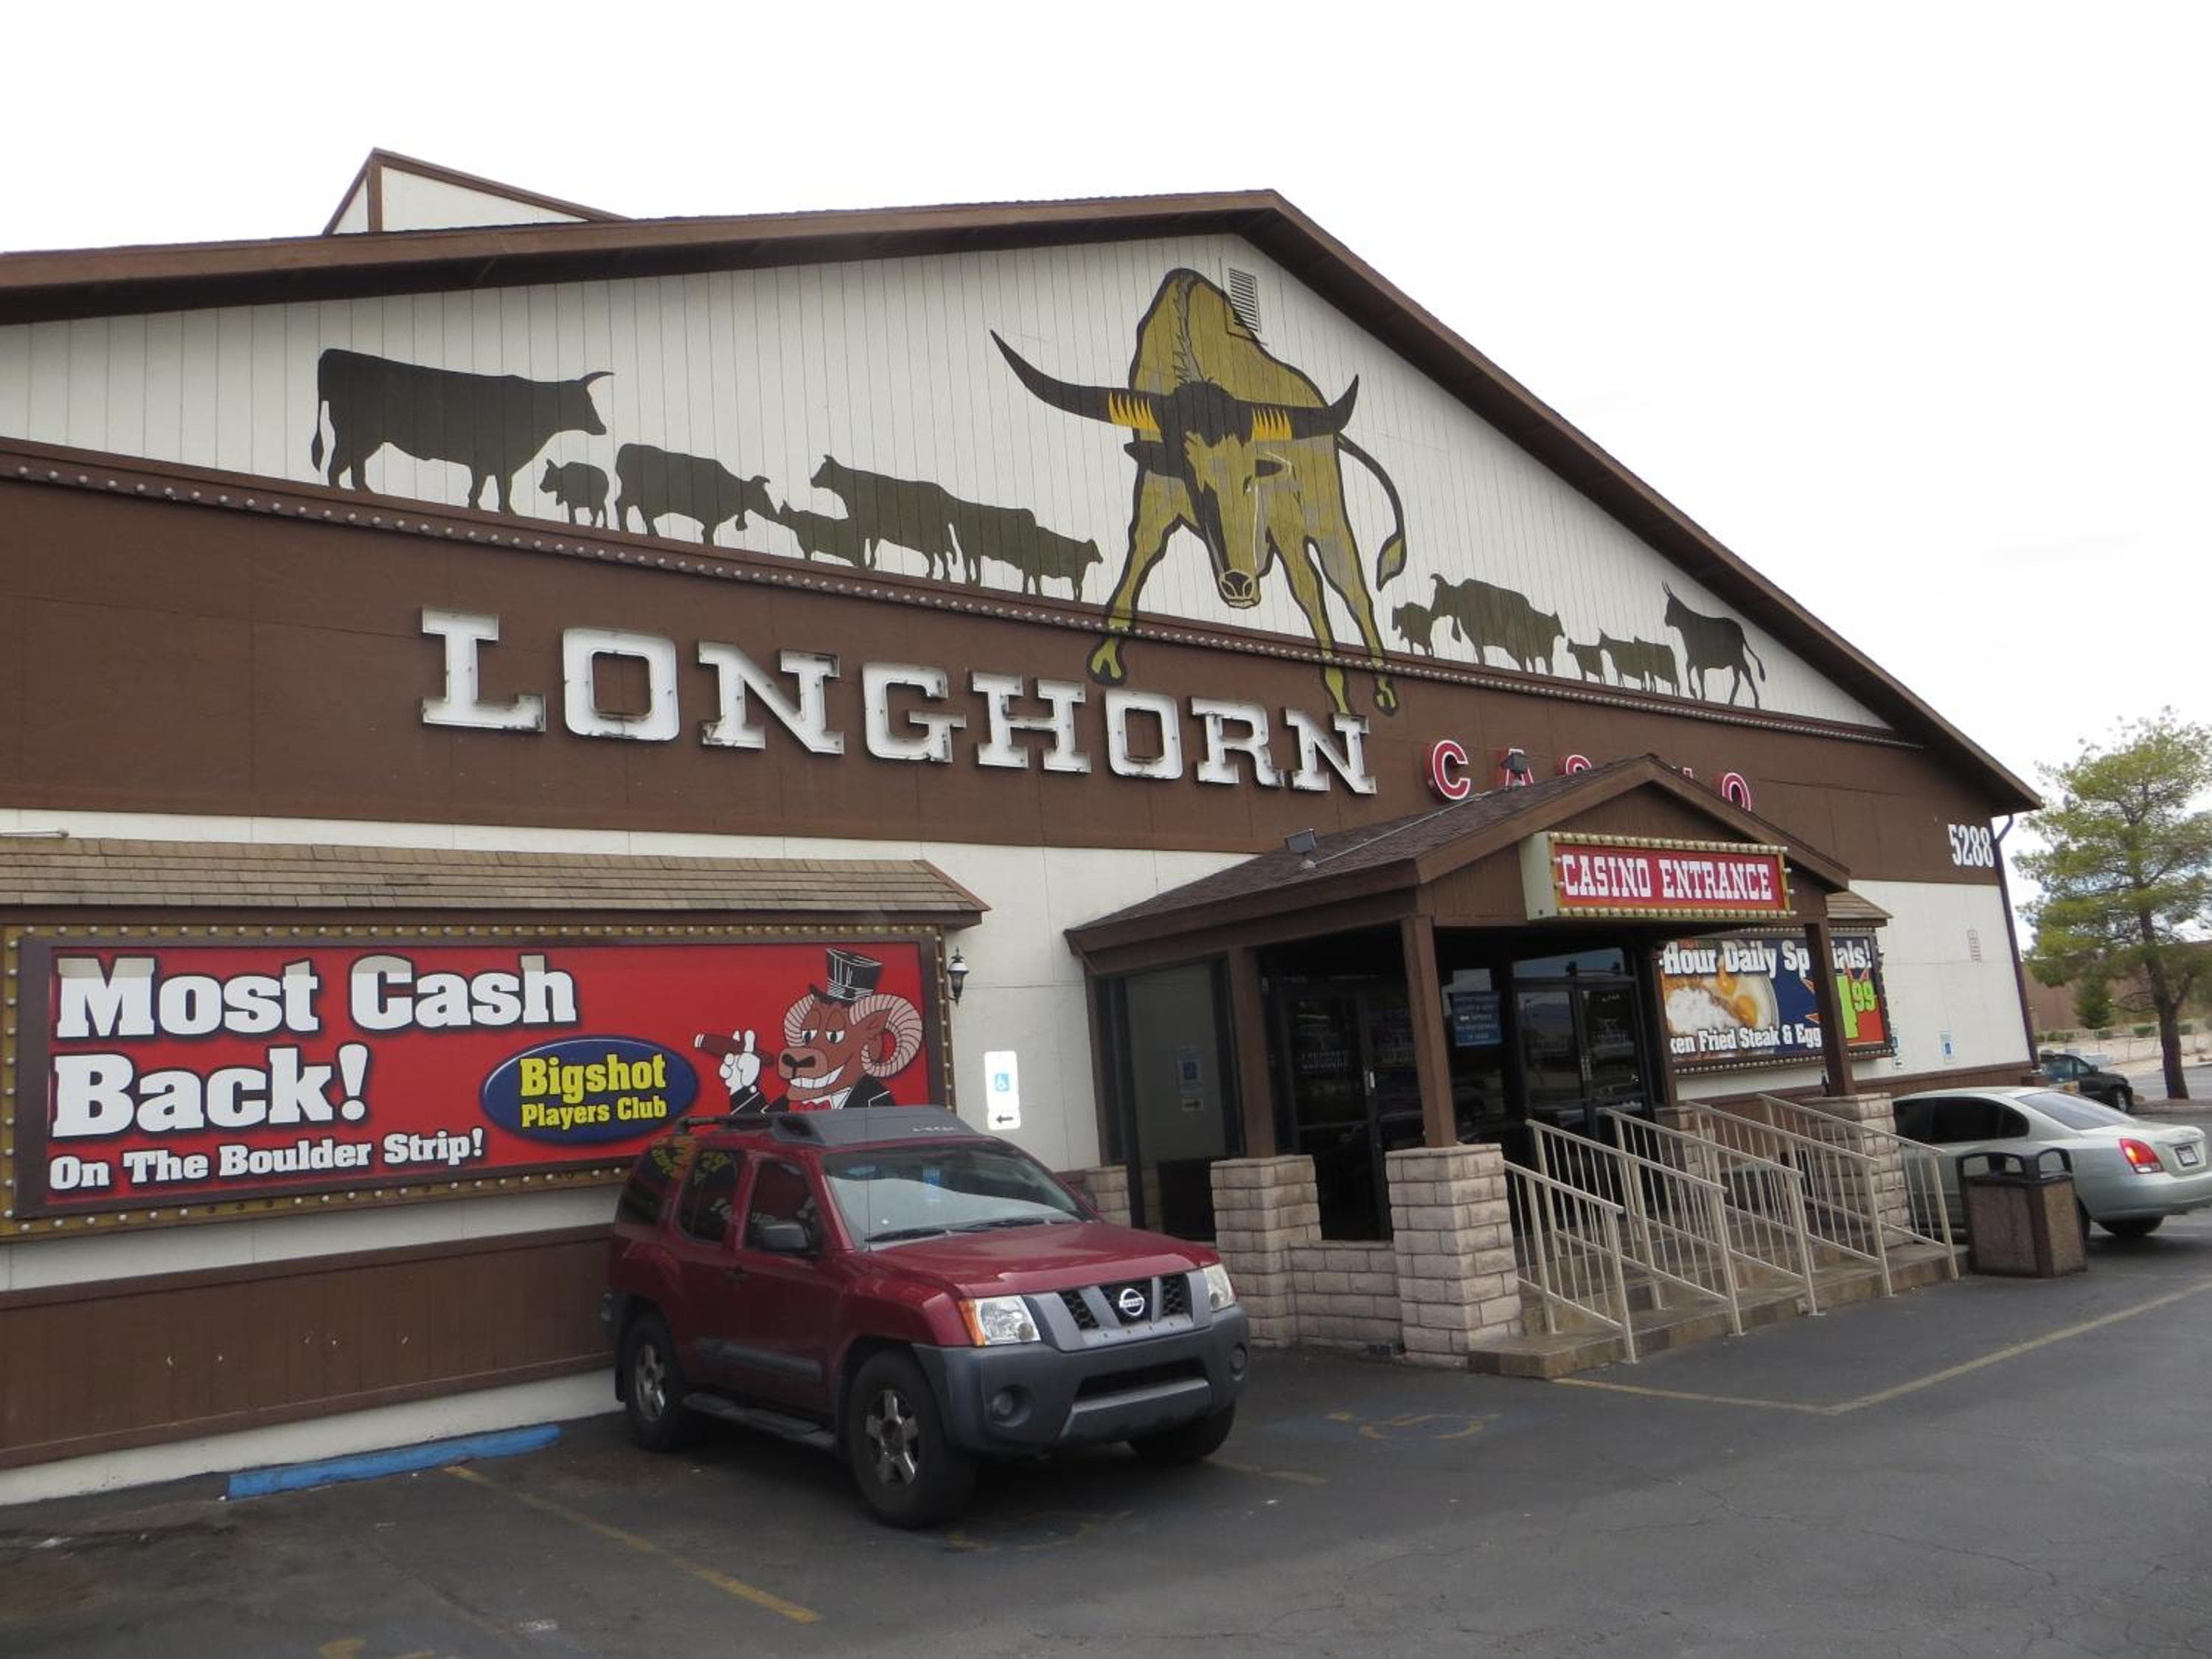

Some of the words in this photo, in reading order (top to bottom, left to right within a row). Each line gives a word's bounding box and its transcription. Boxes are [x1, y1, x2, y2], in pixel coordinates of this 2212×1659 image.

[421, 606, 1377, 795] LONGHORN
[1947, 824, 1994, 867] 5288
[1562, 854, 1652, 897] CASINO
[1659, 859, 1772, 900] ENTRANCE
[1722, 940, 1777, 979] Daily
[56, 957, 319, 1038] Most
[351, 955, 577, 1030] Cash
[1698, 1027, 1738, 1052] Fried
[1739, 1026, 1780, 1048] Steak
[1781, 1024, 1792, 1045] &
[52, 1043, 368, 1138] Back!
[520, 1053, 667, 1104] Bigshot
[521, 1102, 611, 1130] Players
[616, 1095, 667, 1121] Club
[49, 1156, 109, 1191] On
[123, 1150, 209, 1183] The
[219, 1138, 372, 1176] Boulder
[383, 1127, 484, 1165] Strip!
